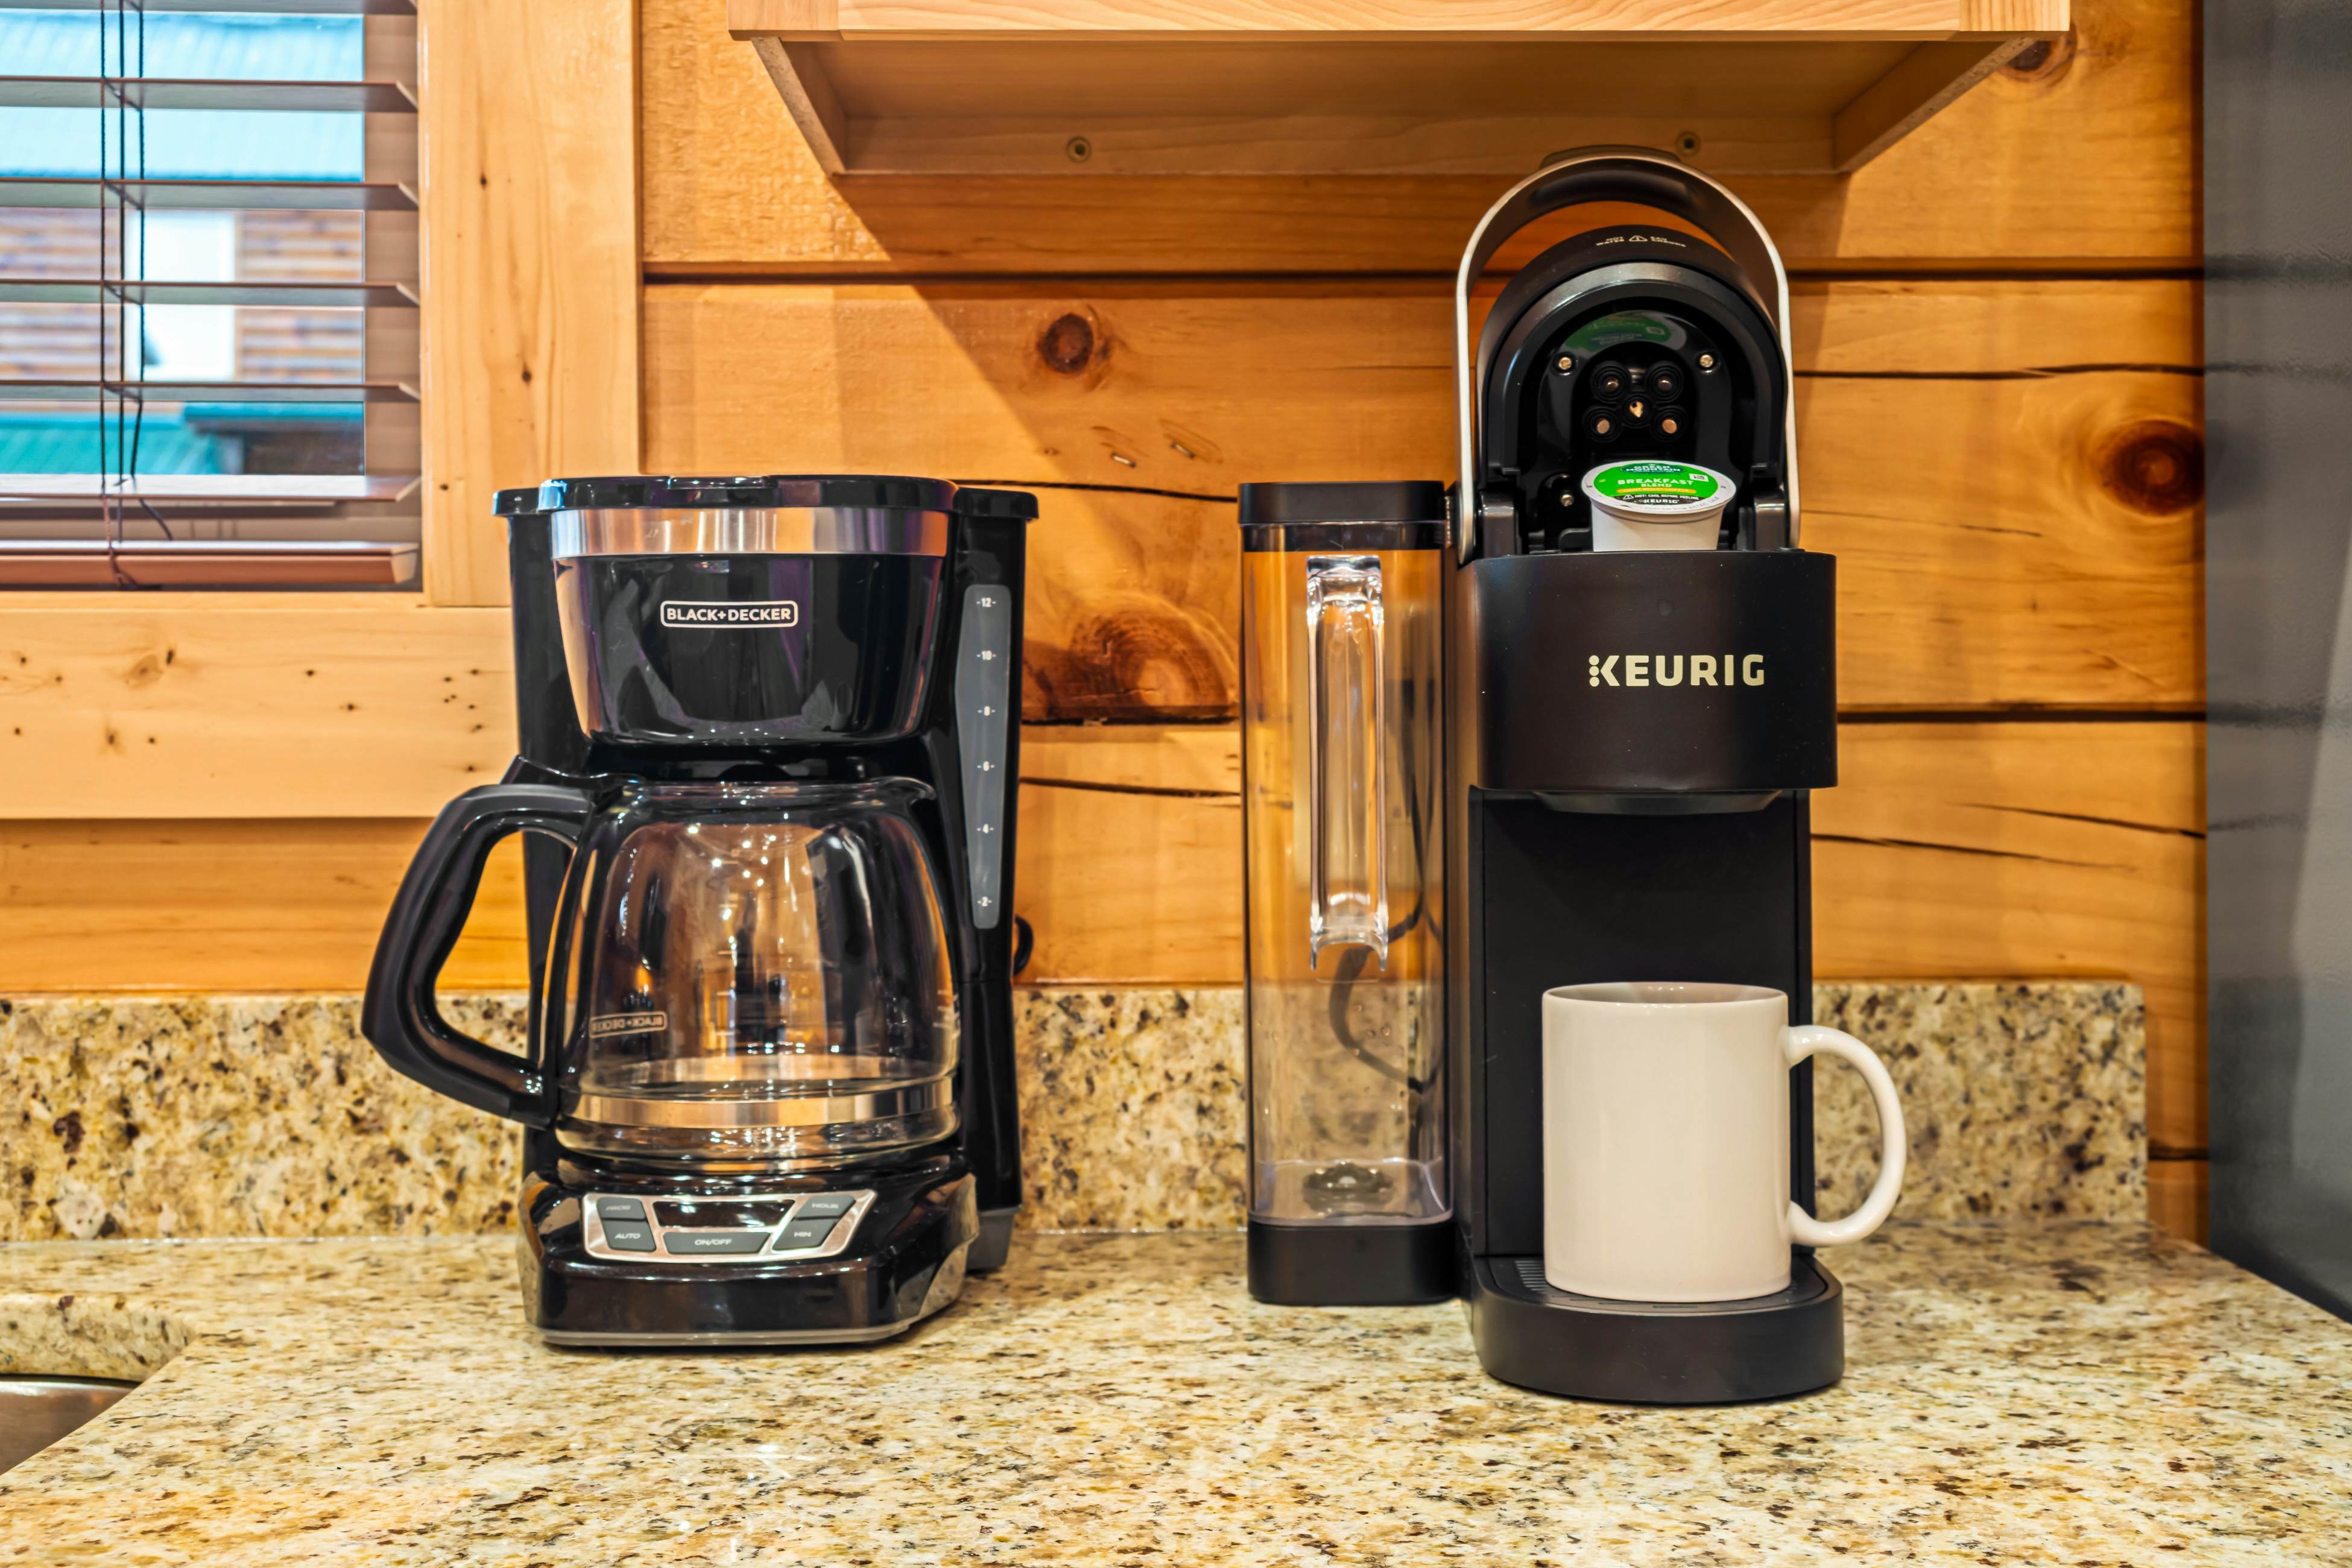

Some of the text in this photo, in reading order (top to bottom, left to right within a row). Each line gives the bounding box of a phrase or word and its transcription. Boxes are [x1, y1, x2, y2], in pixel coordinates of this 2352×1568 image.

[981, 597, 992, 608] 12
[666, 607, 791, 621] BLACK+DECKER
[981, 650, 992, 661] 10
[1589, 654, 1765, 688] KEURIG
[981, 896, 989, 906] 2
